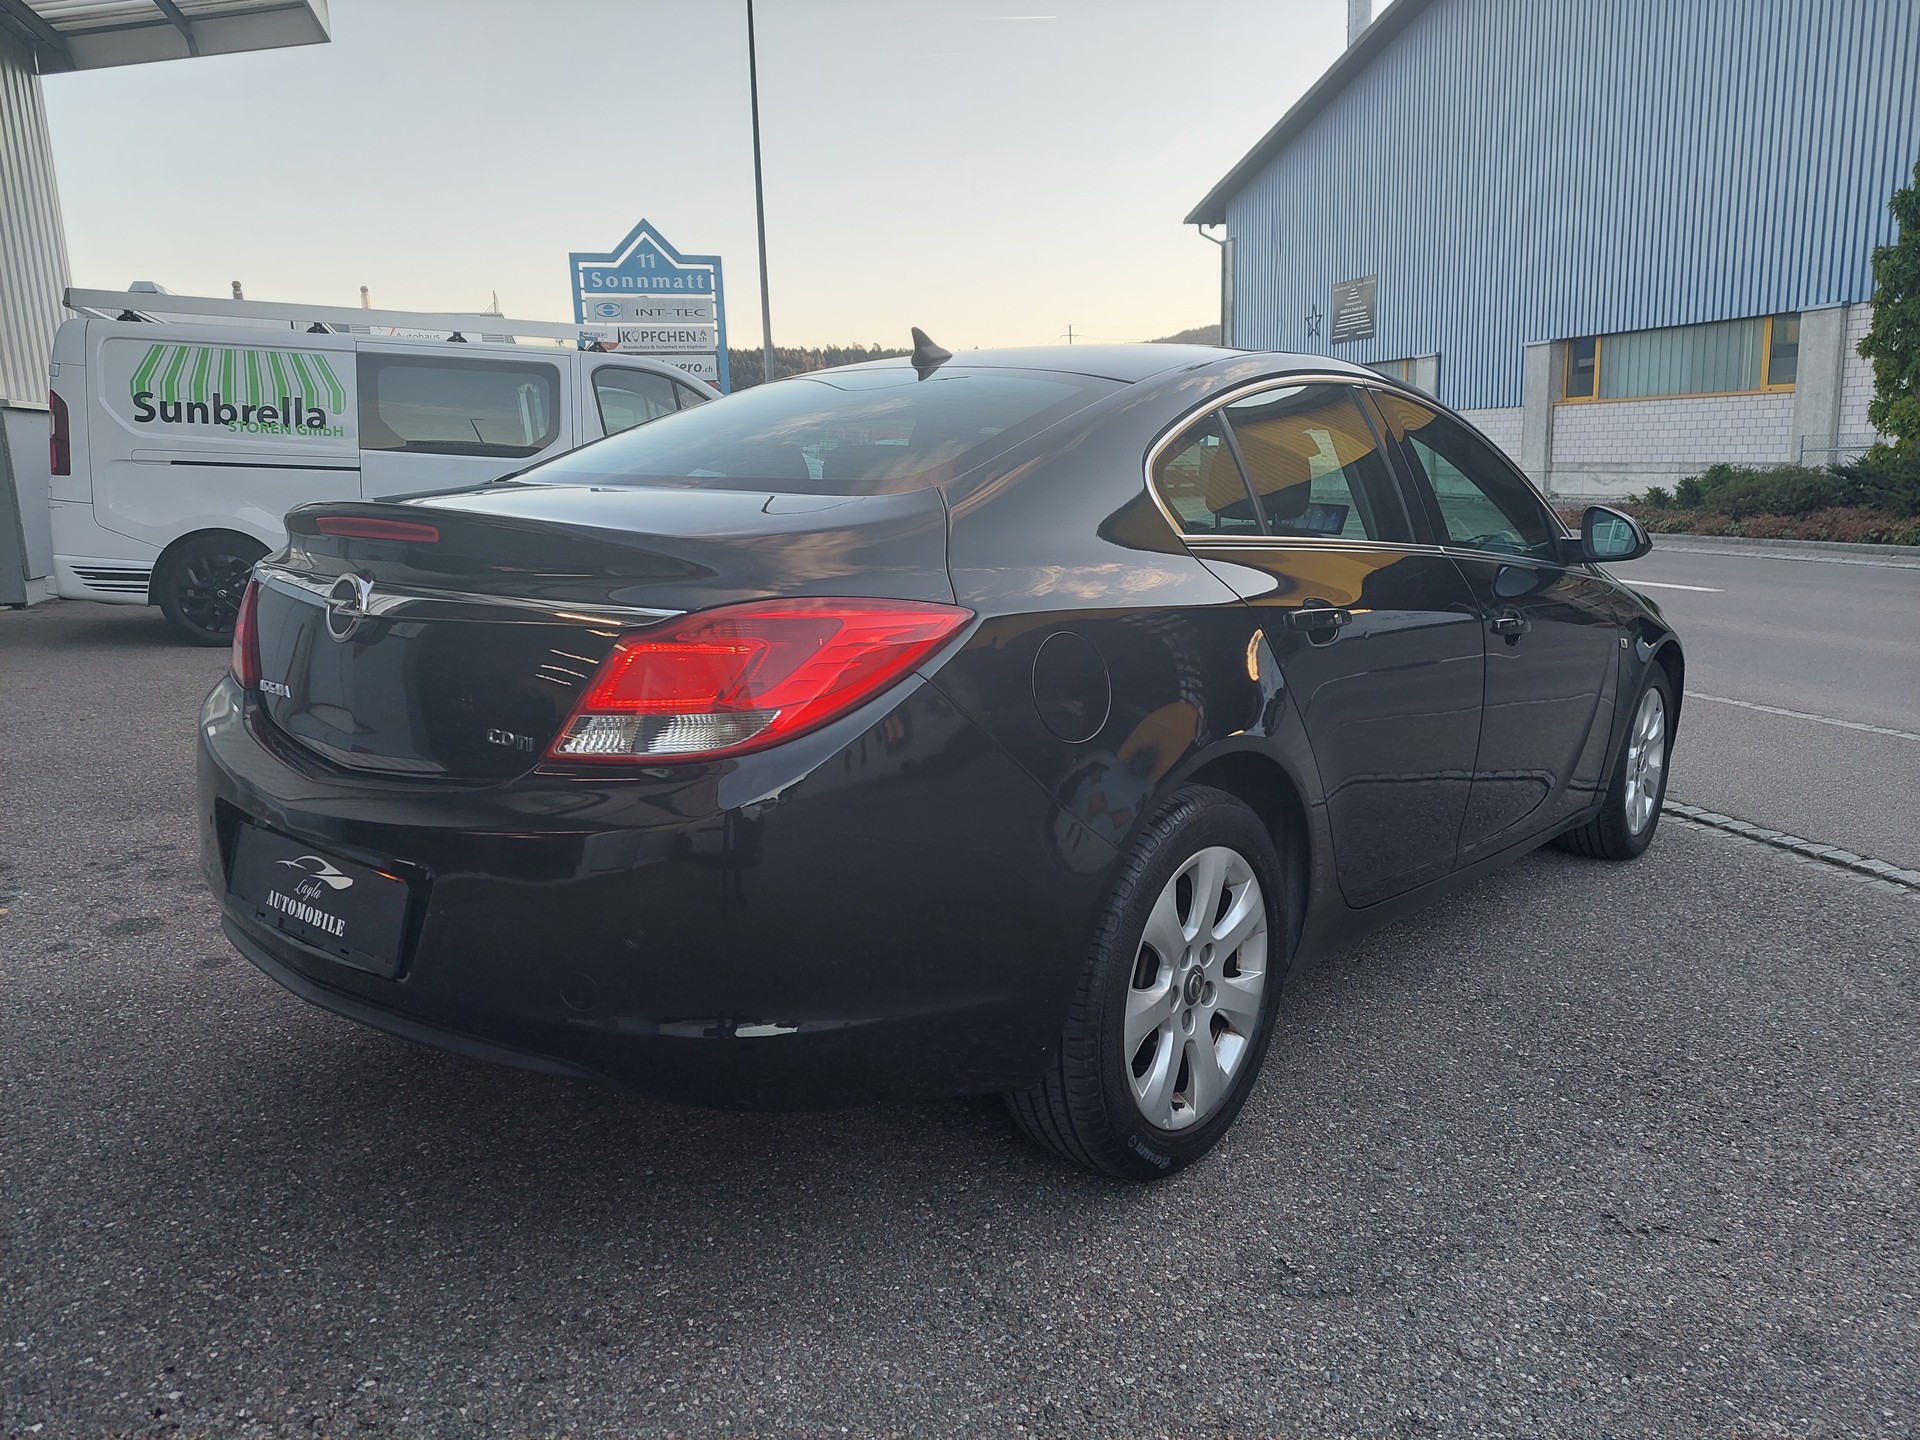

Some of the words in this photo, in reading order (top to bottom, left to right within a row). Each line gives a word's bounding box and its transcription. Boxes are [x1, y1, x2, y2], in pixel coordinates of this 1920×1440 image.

[637, 253, 656, 268] 11
[591, 272, 704, 289] Sonnmatt
[635, 308, 706, 317] INT-TEC
[662, 360, 713, 373] ero.ch
[132, 391, 326, 430] Sunbrella
[228, 420, 291, 435] STOREN
[296, 424, 344, 437] GmbH
[266, 890, 346, 937] AUTOMOBILE
